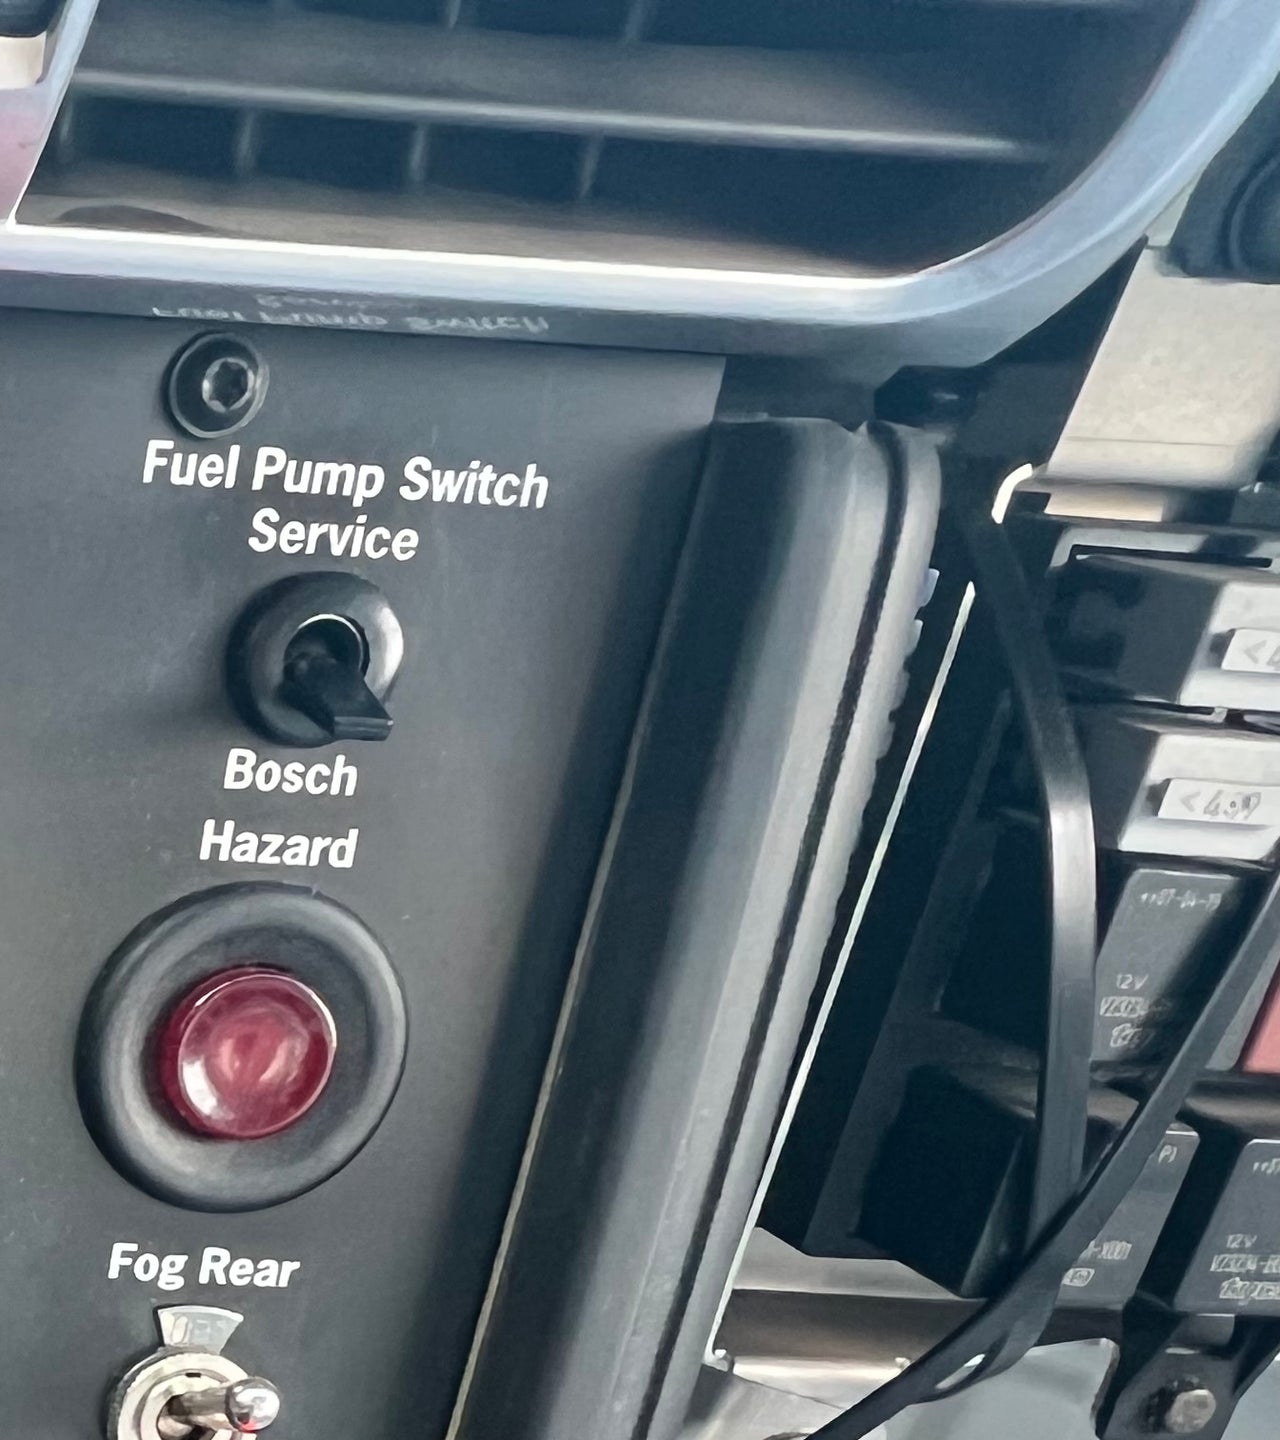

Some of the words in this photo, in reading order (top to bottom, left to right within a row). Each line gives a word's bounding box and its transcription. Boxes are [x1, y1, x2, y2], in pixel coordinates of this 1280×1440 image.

[142, 439, 241, 489] Fuel
[251, 446, 385, 508] Pump
[399, 456, 549, 509] Switch
[248, 507, 420, 561] Service
[223, 748, 358, 797] Bosch
[199, 818, 359, 869] Hazard
[107, 1242, 185, 1291] Fog
[198, 1246, 301, 1288] Rear
